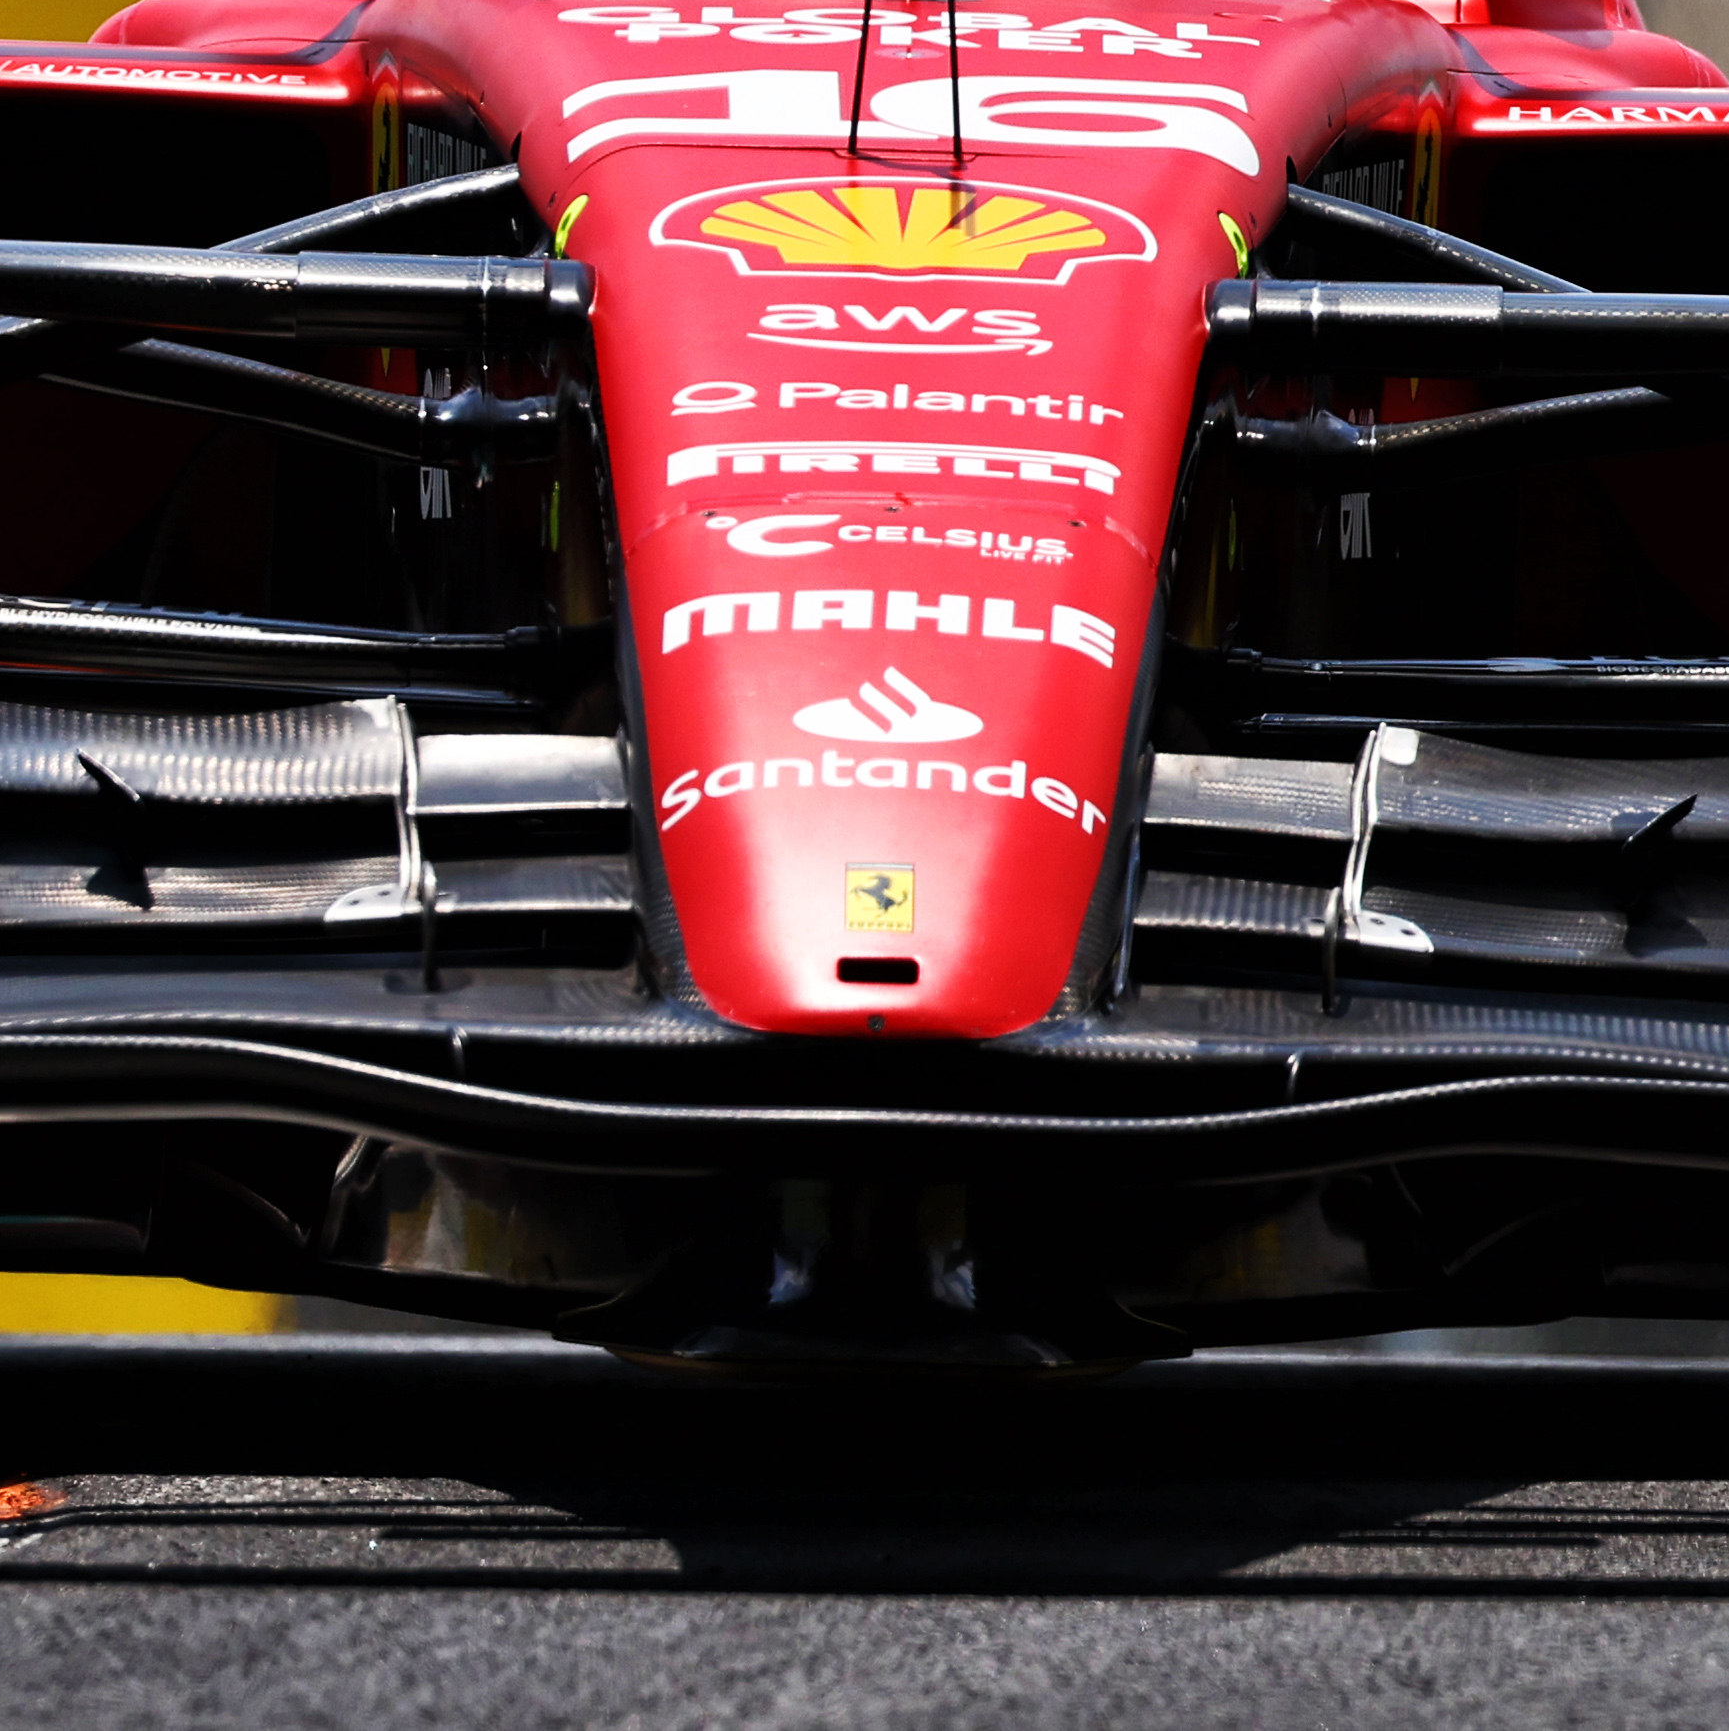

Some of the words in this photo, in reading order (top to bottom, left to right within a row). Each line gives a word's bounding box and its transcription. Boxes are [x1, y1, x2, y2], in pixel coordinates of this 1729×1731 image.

[558, 5, 1260, 46] GLOBAL
[615, 22, 1202, 60] POKER
[14, 63, 308, 85] AUTOMOTIVE
[562, 68, 1262, 177] 16
[758, 303, 1042, 337] aws
[780, 382, 1124, 426] Palantir
[667, 440, 1121, 495] PIRELLI
[838, 523, 1068, 557] CELSIUS
[980, 548, 1026, 562] LIVE
[661, 589, 1115, 669] MAHLE
[661, 749, 1106, 835] Santander
